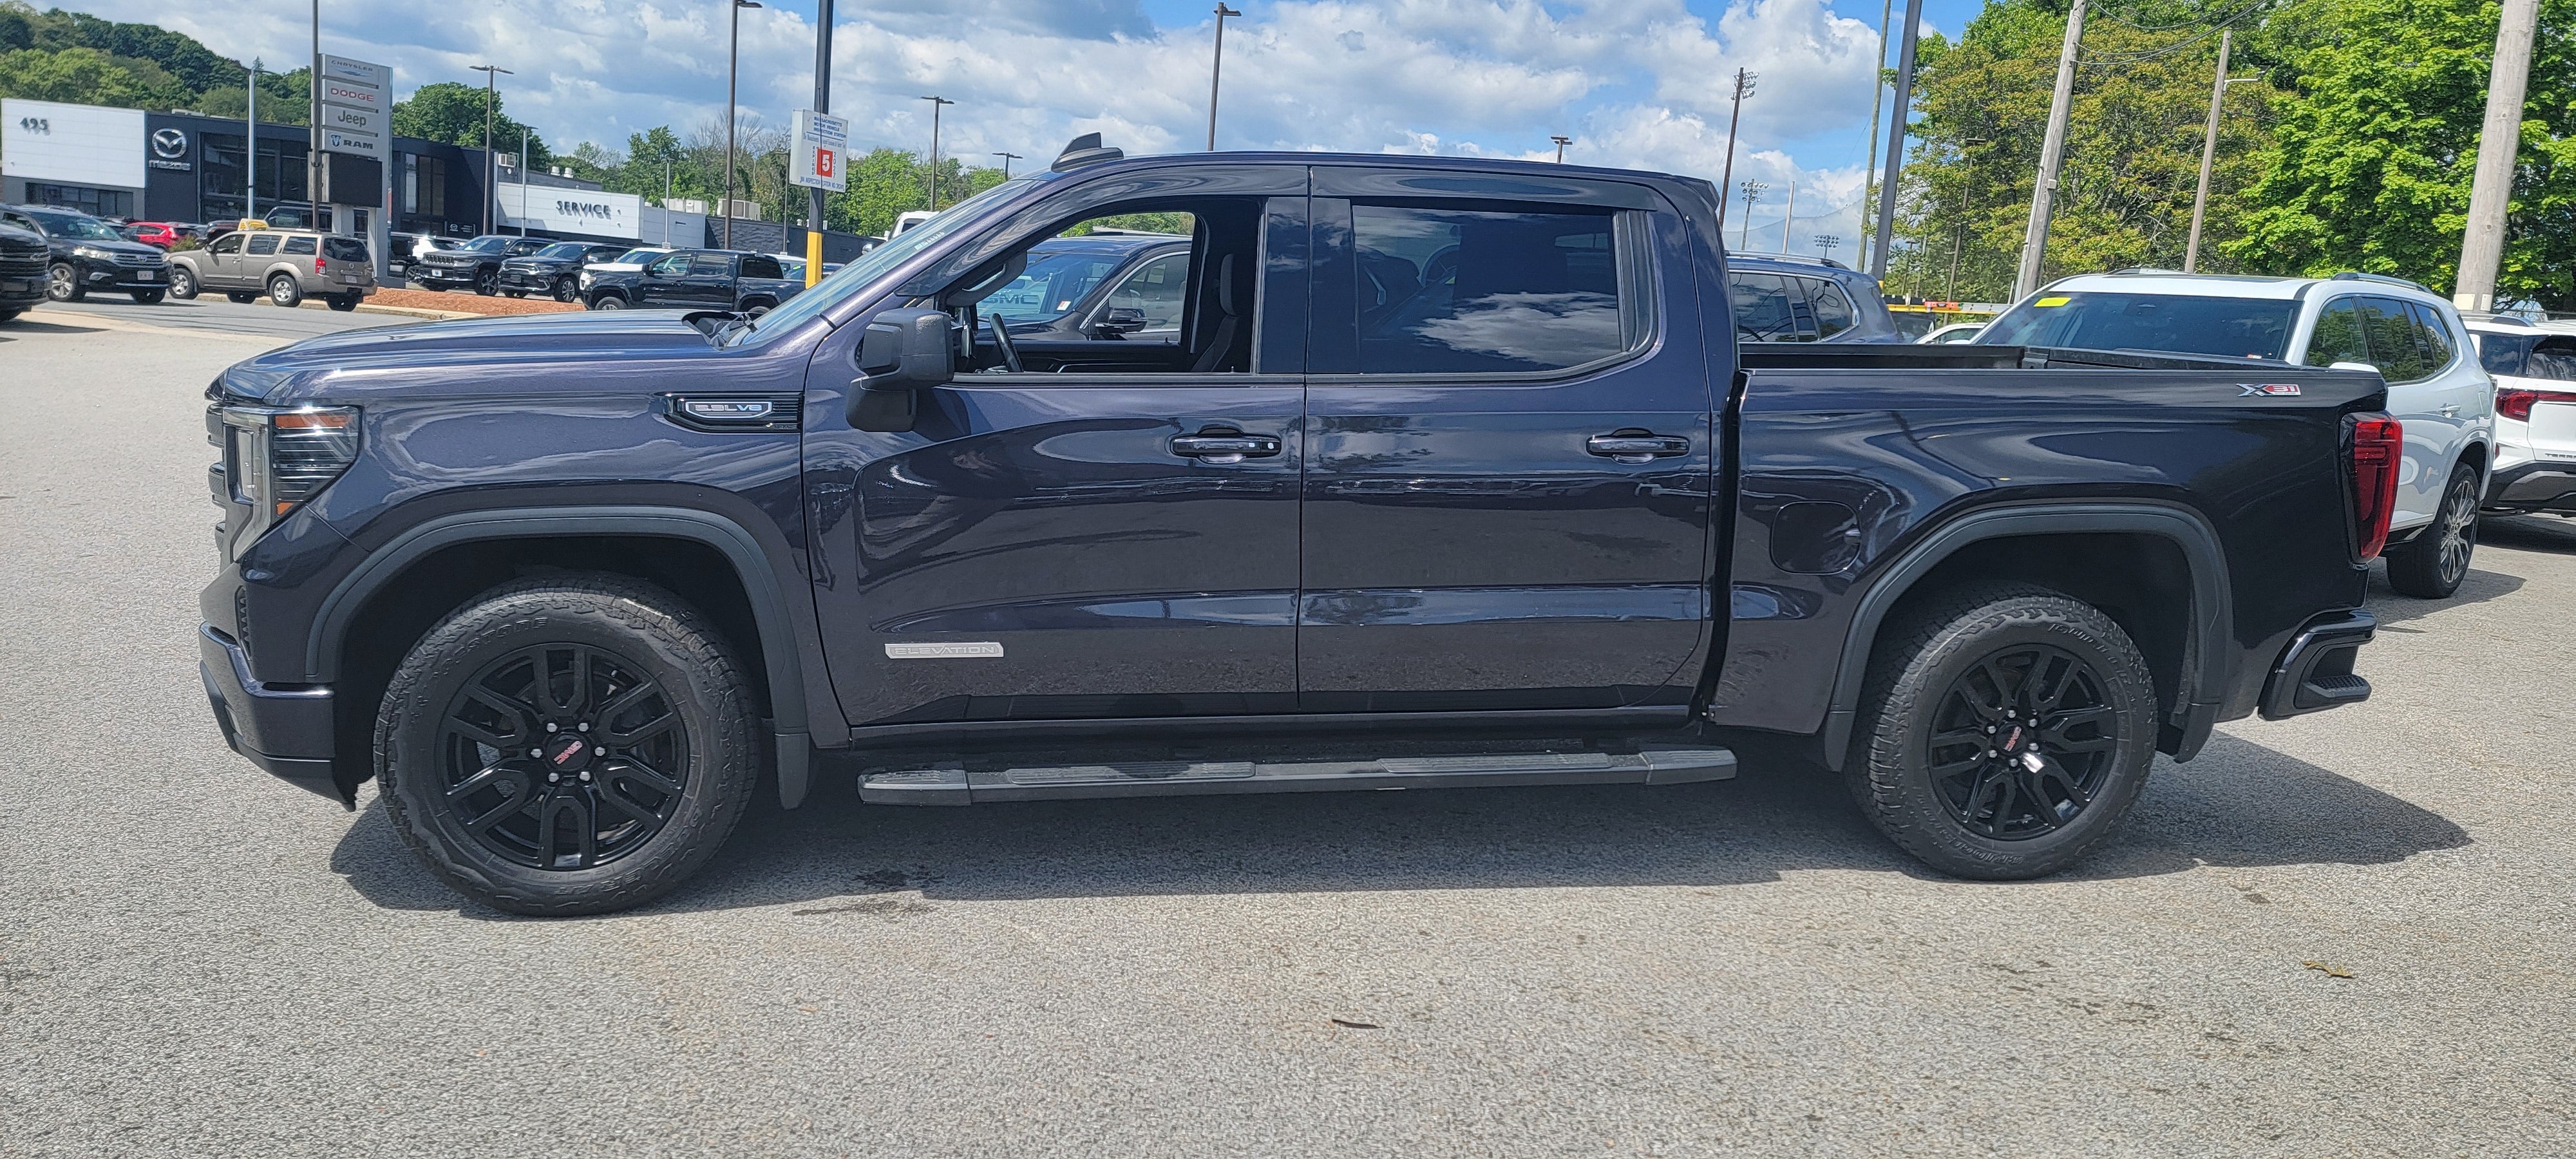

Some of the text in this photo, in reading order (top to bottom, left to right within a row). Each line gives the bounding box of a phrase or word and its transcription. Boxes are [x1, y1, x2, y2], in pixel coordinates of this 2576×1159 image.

[331, 60, 373, 71] CHRYSLER
[330, 88, 374, 102] DODGE
[19, 117, 48, 129] 495
[337, 110, 366, 127] Jeep
[813, 116, 842, 127] MASACHUSETTS
[813, 127, 833, 136] INSECTION
[343, 139, 374, 149] RAM
[822, 155, 830, 172] 5
[556, 200, 611, 216] SERVICE
[894, 645, 995, 655] ELEVATION
[2003, 726, 2022, 752] GMC
[553, 740, 583, 765] GMC
